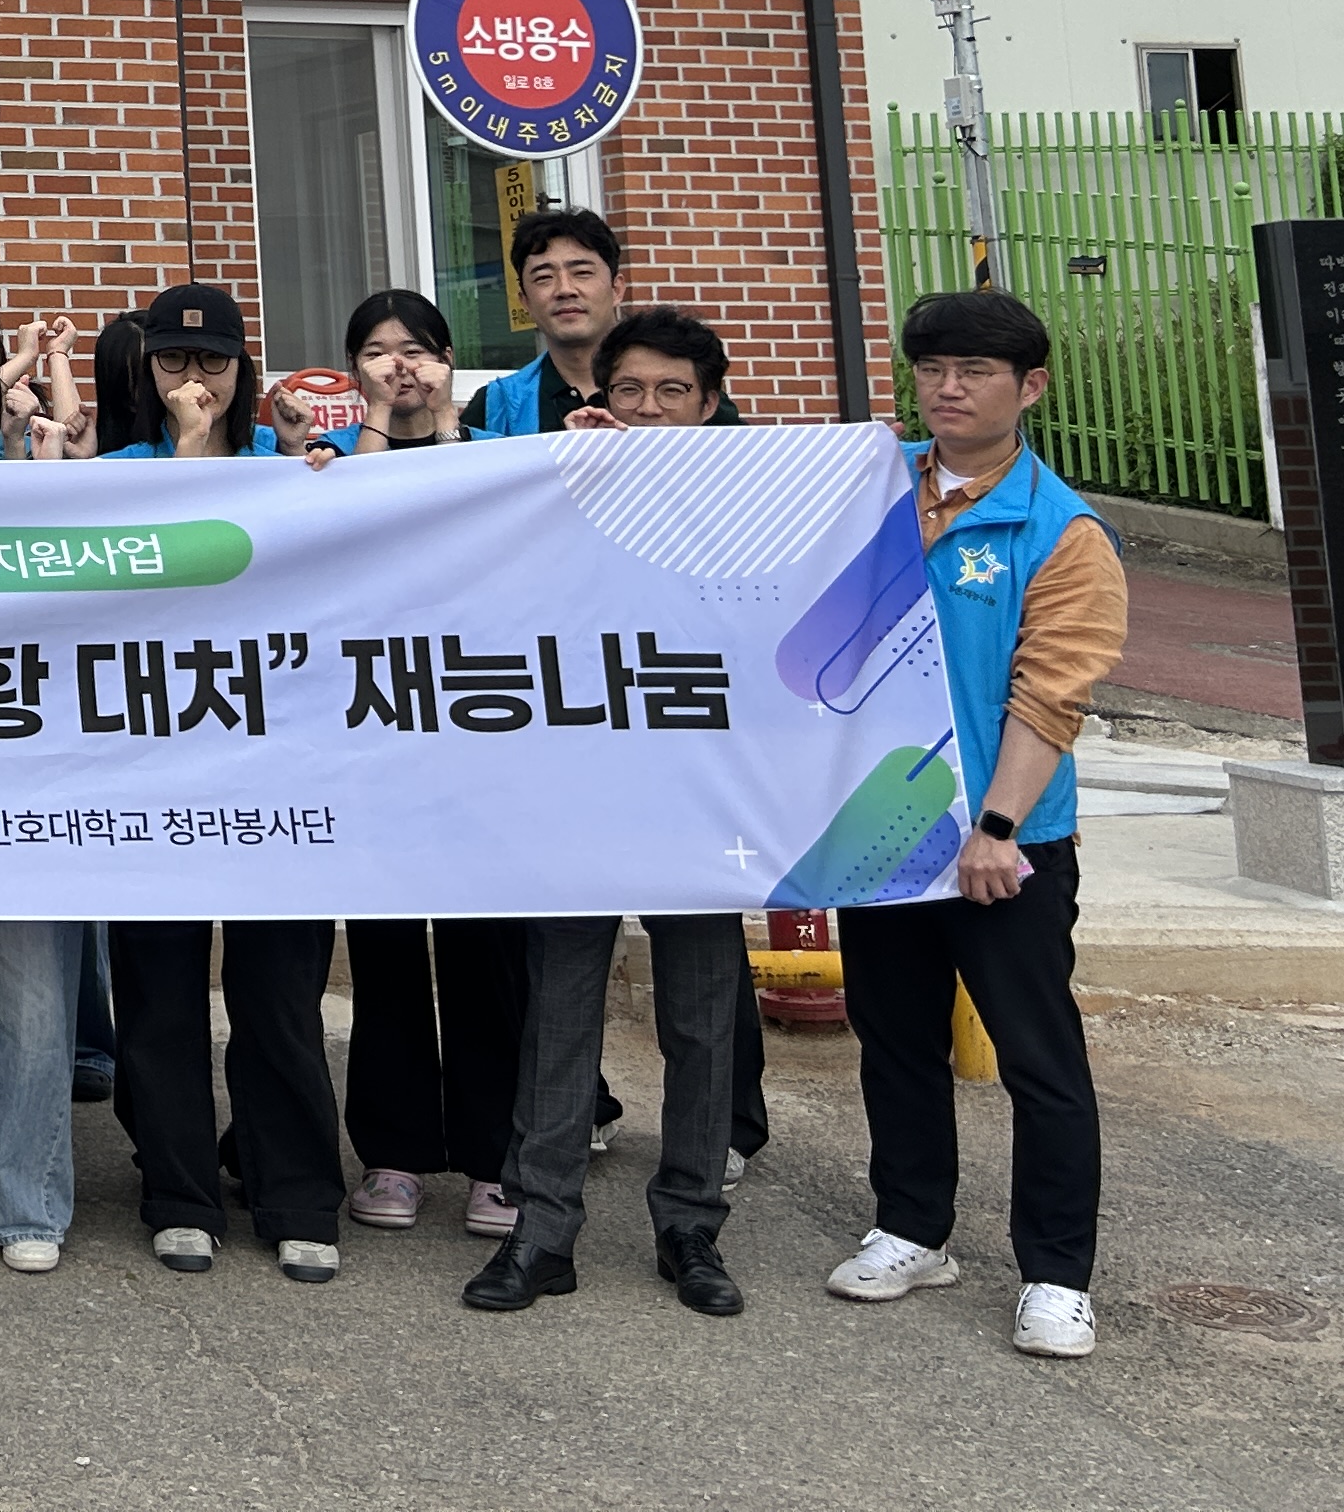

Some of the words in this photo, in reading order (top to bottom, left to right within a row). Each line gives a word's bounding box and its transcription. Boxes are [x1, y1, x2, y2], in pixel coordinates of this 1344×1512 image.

[462, 16, 591, 63] 소방용수
[533, 76, 556, 90] 8호
[311, 404, 365, 431] 차금지
[77, 633, 308, 737] 대처”
[341, 632, 729, 732] 재능나눔
[161, 806, 335, 845] 청라봉사단
